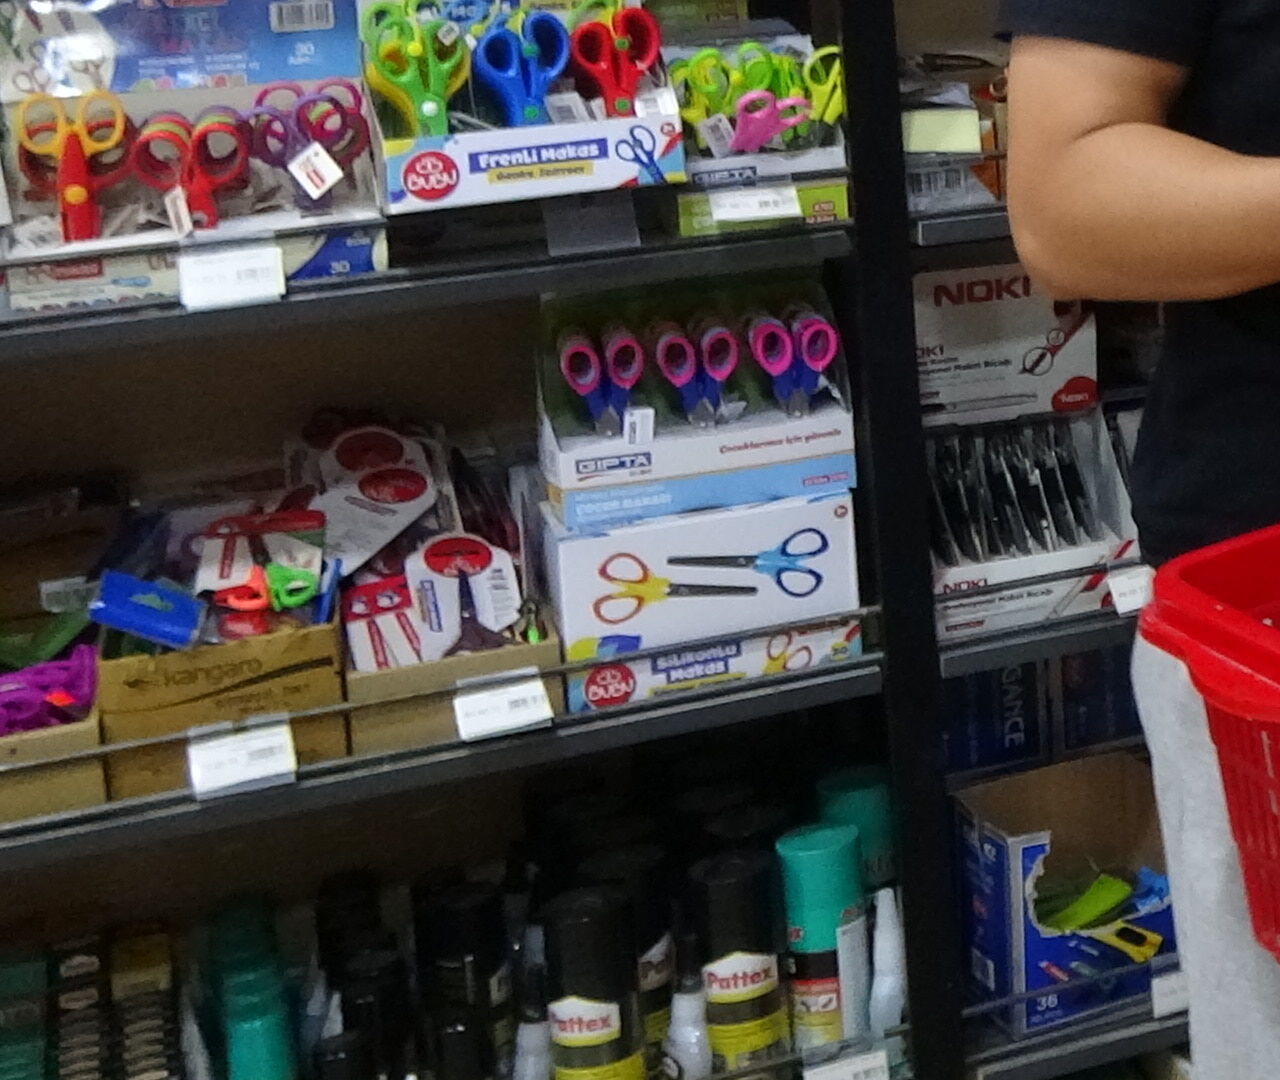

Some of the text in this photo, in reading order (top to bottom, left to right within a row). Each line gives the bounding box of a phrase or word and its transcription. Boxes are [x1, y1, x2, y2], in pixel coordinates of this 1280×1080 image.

[479, 141, 600, 169] Frenli Makas
[933, 275, 1031, 308] NOKI
[576, 454, 652, 474] GIPTA
[943, 577, 989, 595] NOKI
[162, 655, 264, 691] kangaro
[1002, 667, 1025, 748] GANCE
[705, 965, 773, 990] Pattex
